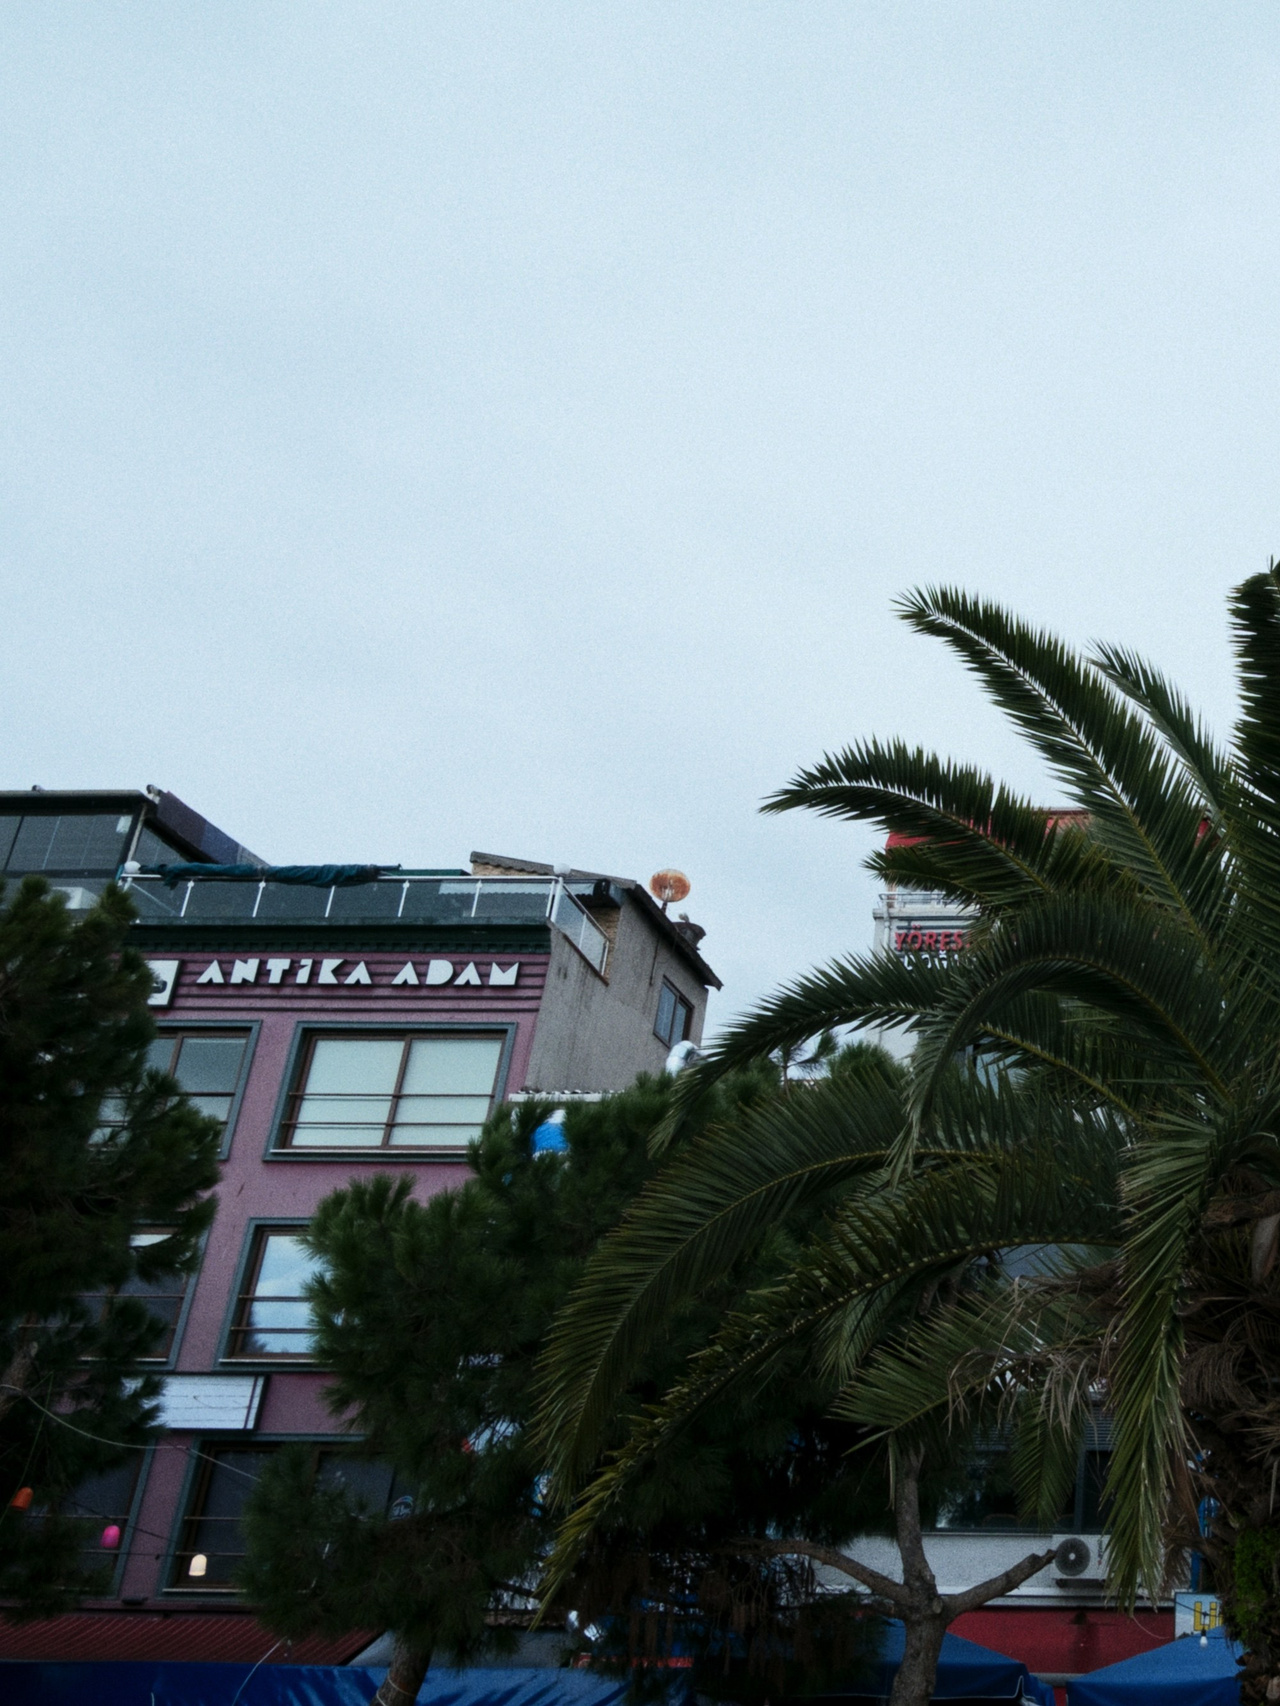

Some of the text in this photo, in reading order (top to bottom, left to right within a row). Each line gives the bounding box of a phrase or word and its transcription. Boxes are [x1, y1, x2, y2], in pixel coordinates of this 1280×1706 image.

[895, 924, 971, 951] YÖRES
[391, 959, 520, 986] ADAM
[1194, 1601, 1224, 1631] Li
